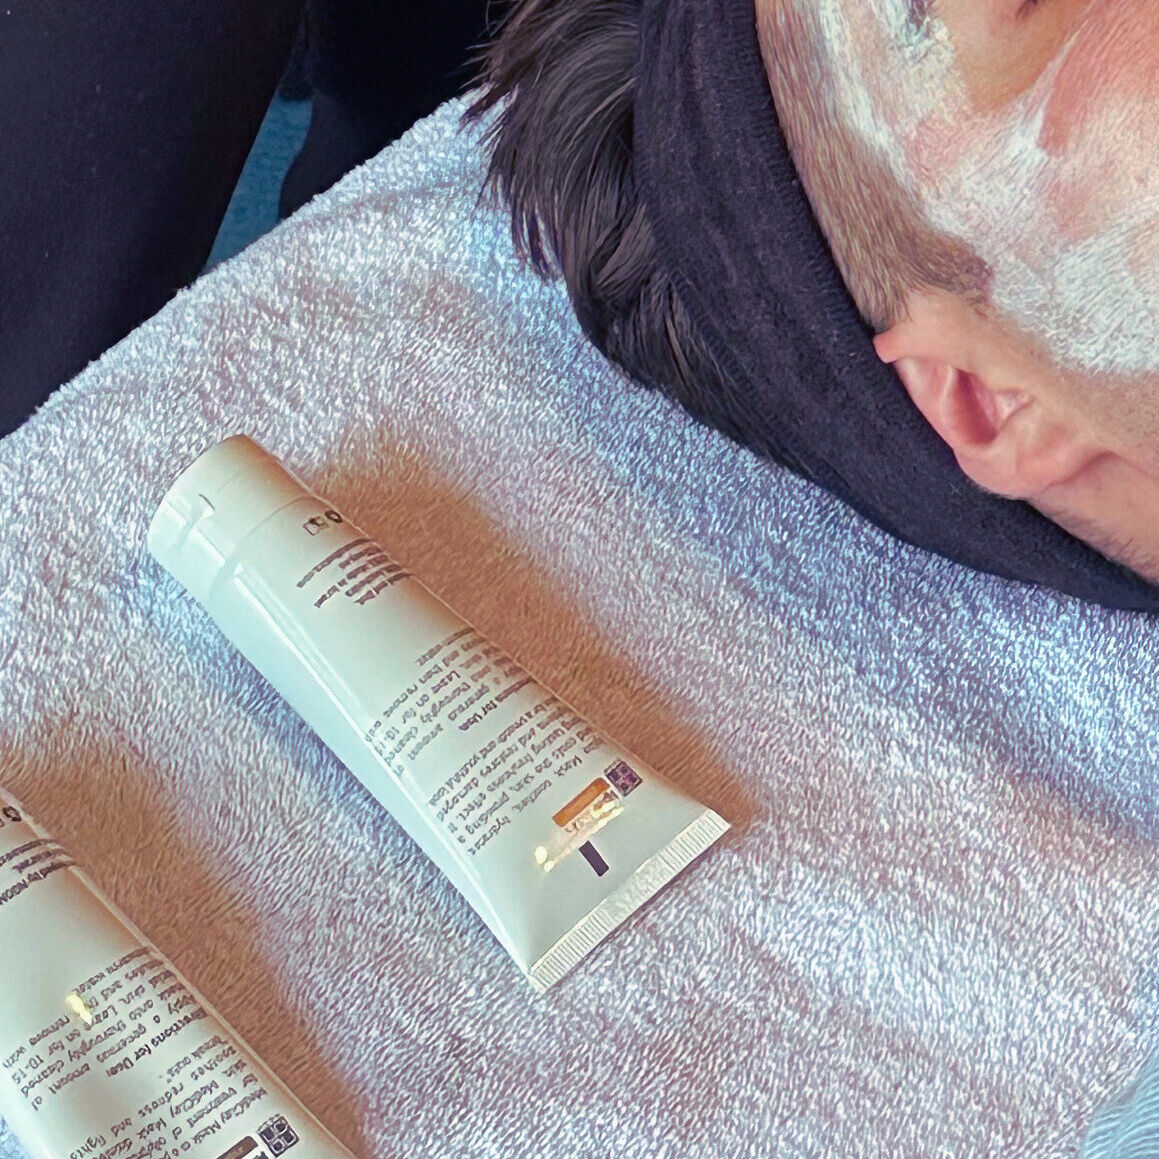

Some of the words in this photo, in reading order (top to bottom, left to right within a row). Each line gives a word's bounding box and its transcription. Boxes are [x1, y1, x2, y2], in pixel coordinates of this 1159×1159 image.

[402, 723, 443, 760] amount
[518, 727, 536, 747] and
[534, 758, 553, 773] the
[465, 791, 509, 834] providing
[48, 1040, 65, 1056] for
[68, 1020, 126, 1062] thoroughly
[97, 1023, 146, 1062] generous
[134, 1044, 152, 1061] for
[138, 1083, 184, 1117] redness
[111, 1118, 132, 1137] and
